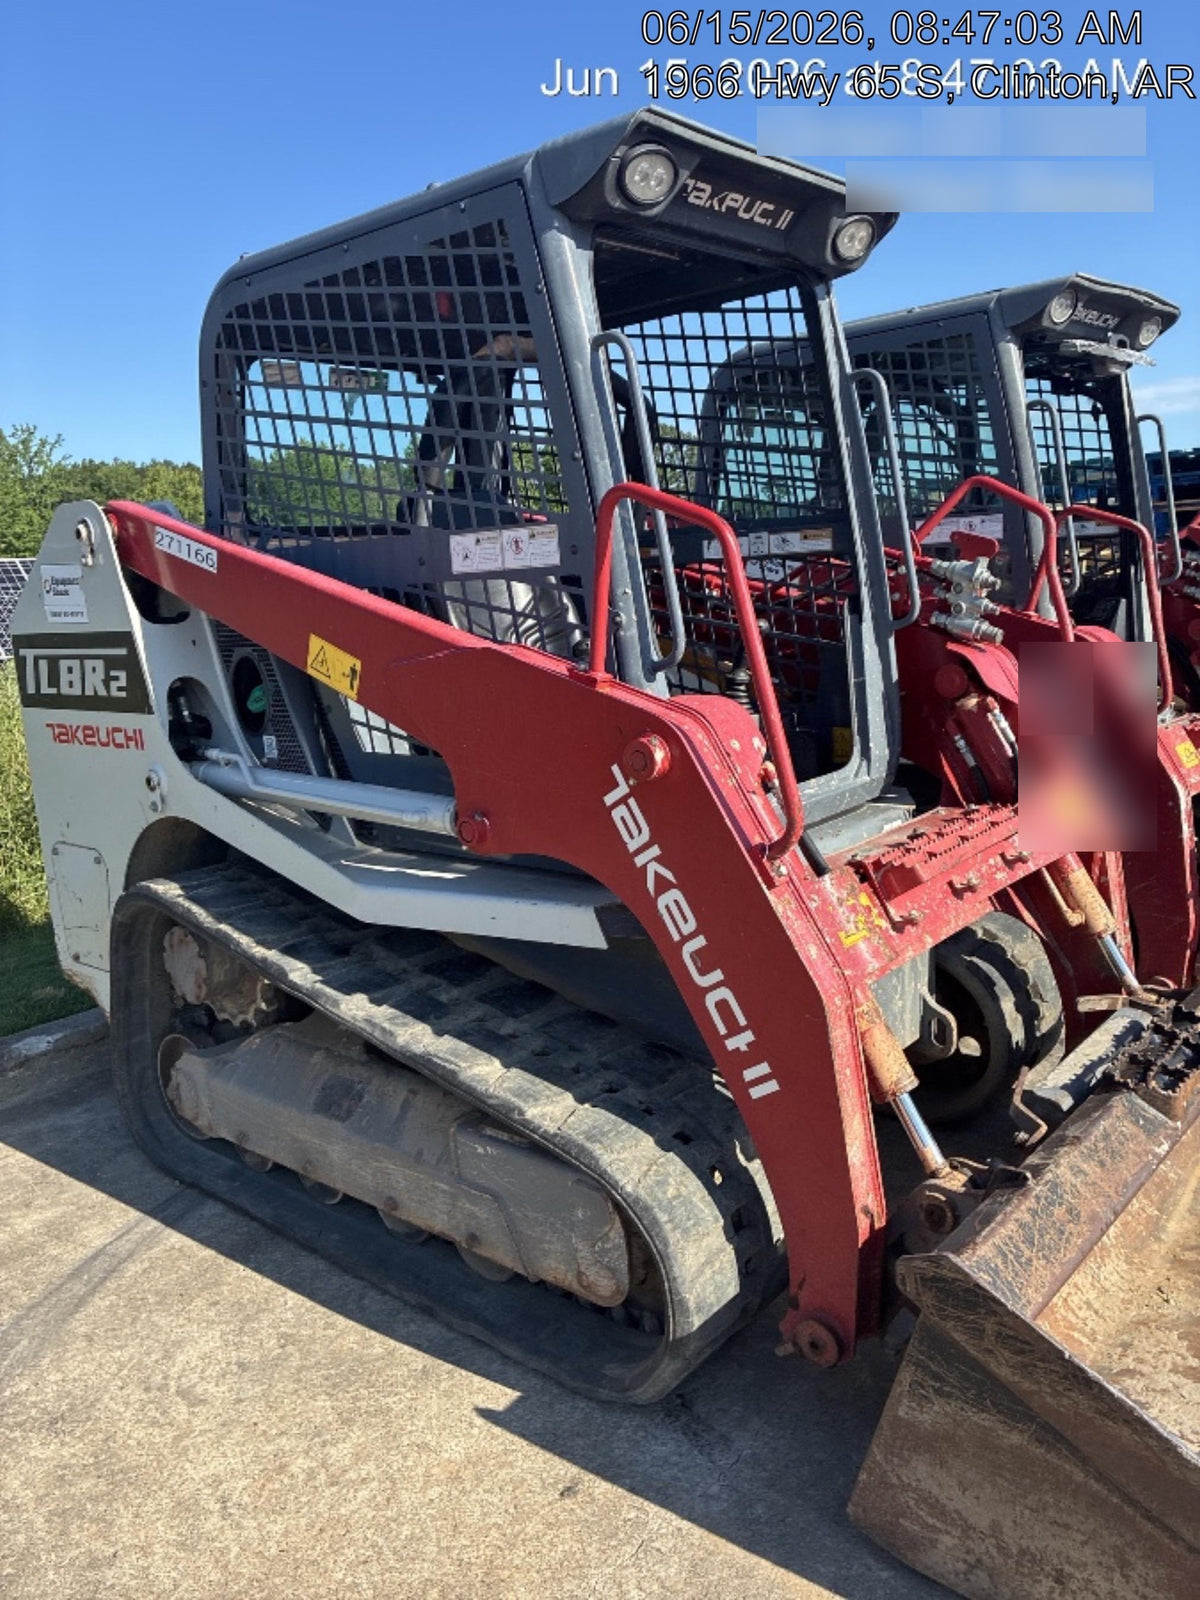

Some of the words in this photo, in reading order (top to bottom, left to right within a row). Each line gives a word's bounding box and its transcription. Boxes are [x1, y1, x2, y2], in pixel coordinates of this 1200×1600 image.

[1069, 302, 1121, 330] AKEUCHI
[155, 530, 216, 569] 271166
[19, 648, 128, 698] TL8R2
[45, 723, 146, 751] TAKEUCHI
